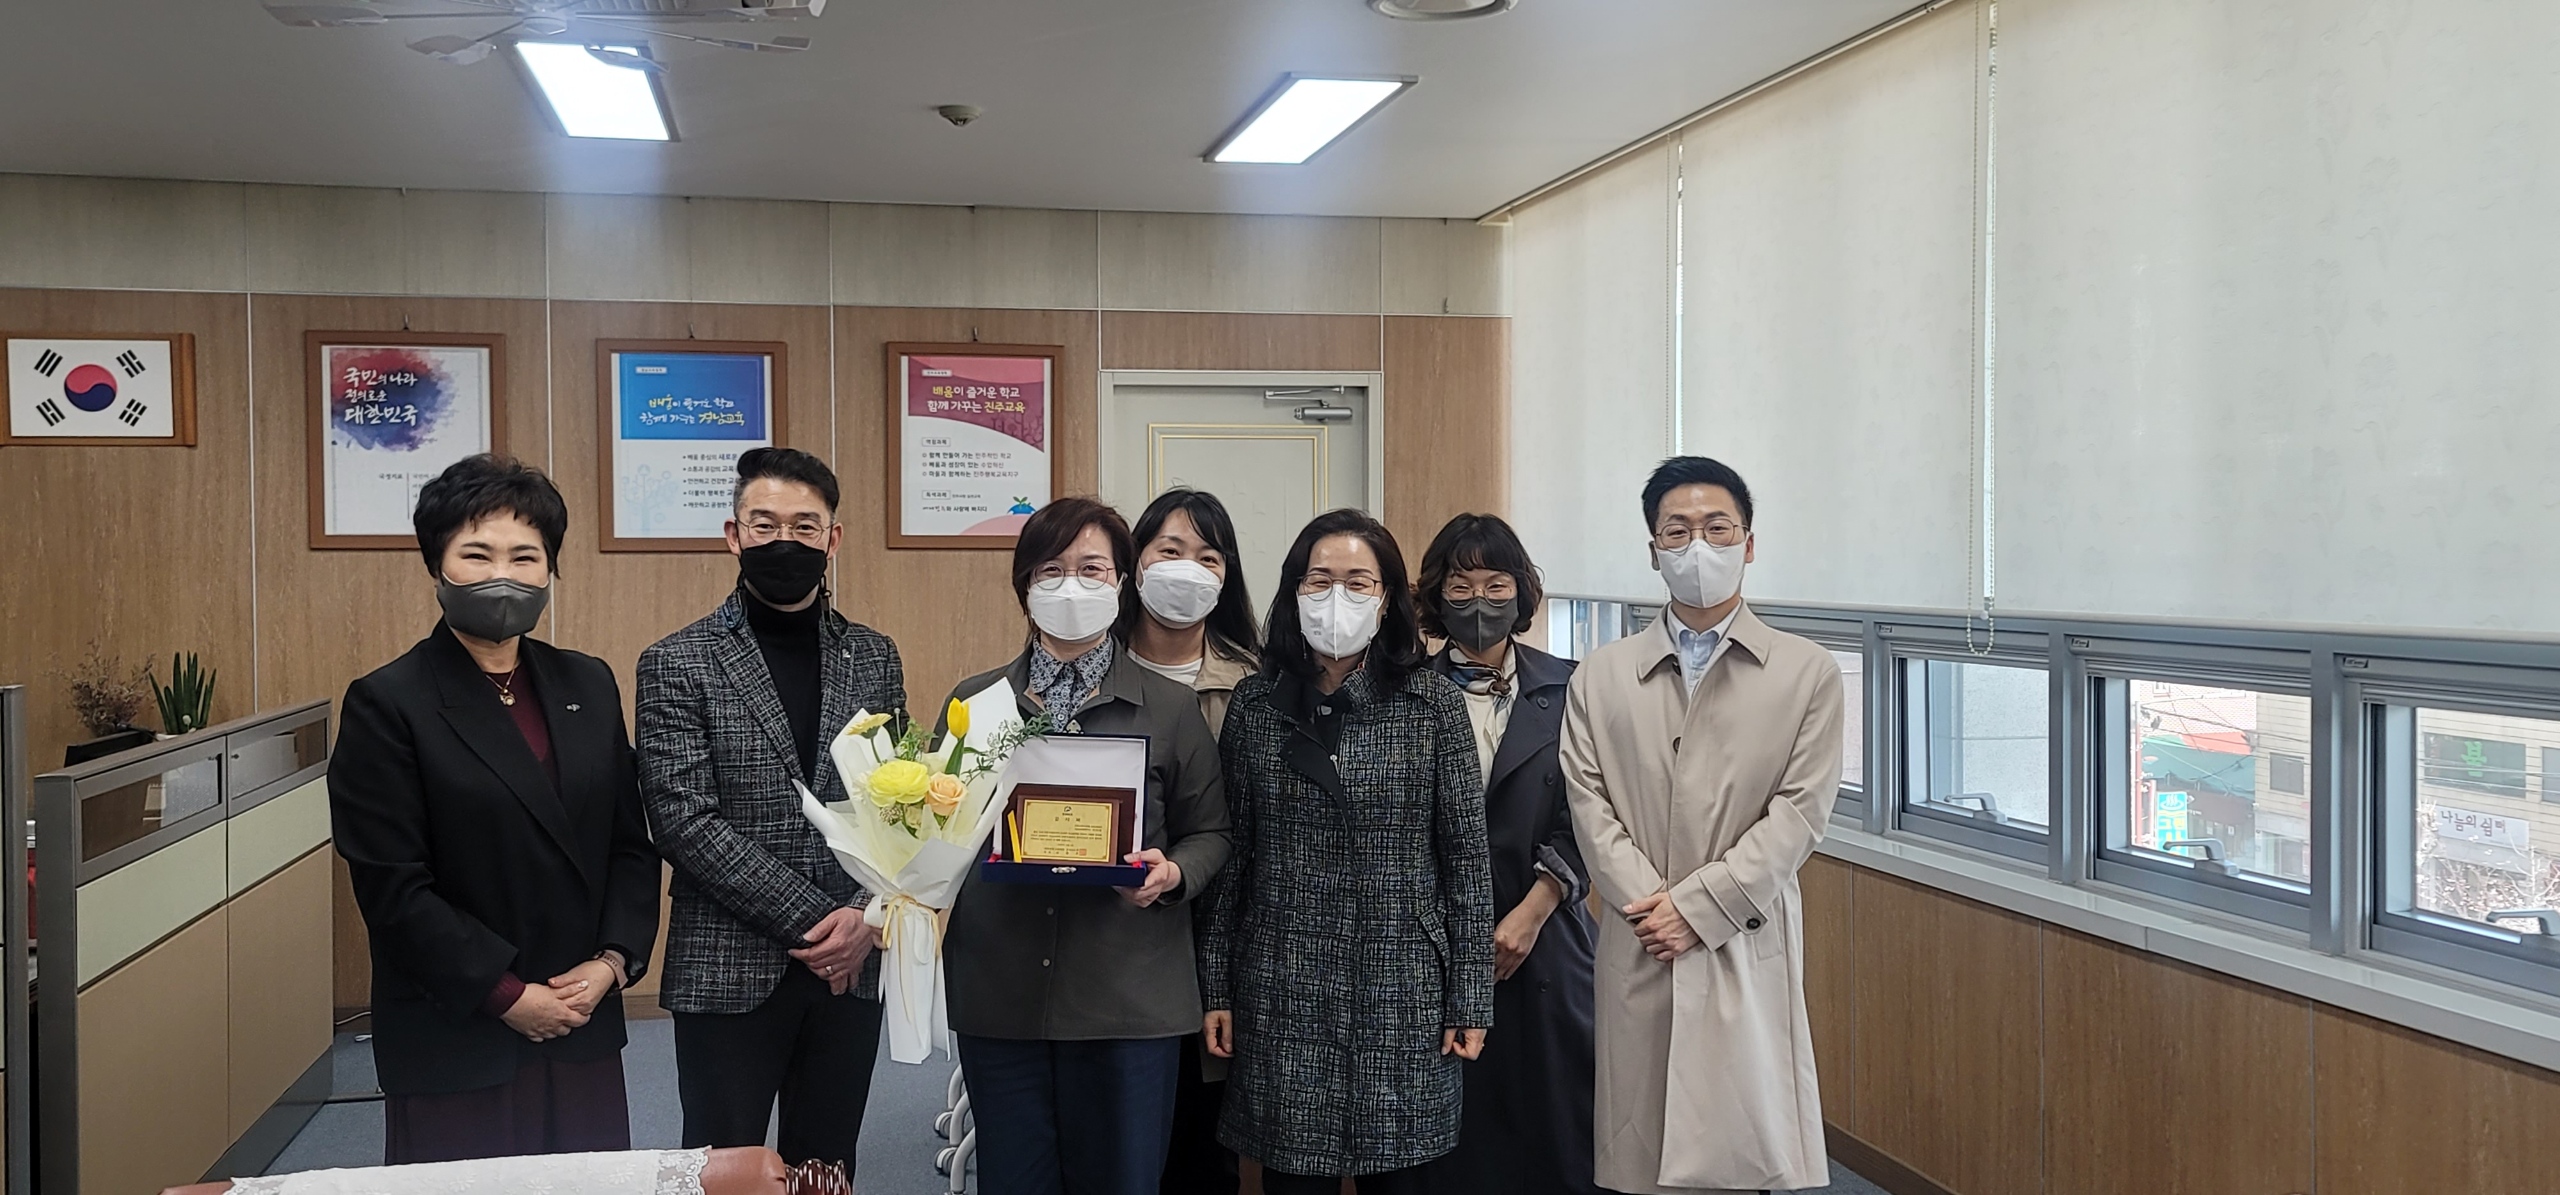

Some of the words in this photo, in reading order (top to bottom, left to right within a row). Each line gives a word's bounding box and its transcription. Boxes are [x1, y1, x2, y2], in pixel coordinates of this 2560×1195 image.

[343, 367, 387, 388] 국민의
[389, 372, 419, 387] 나라
[345, 388, 388, 403] 정의로운
[932, 386, 964, 398] 배움이
[966, 386, 997, 399] 즐거운
[999, 387, 1020, 399] 학교
[648, 393, 681, 410] 배움이
[927, 401, 949, 413] 함께
[950, 401, 982, 413] 가꾸는
[984, 401, 1025, 414] 진주교육
[344, 404, 419, 427] 대한민국
